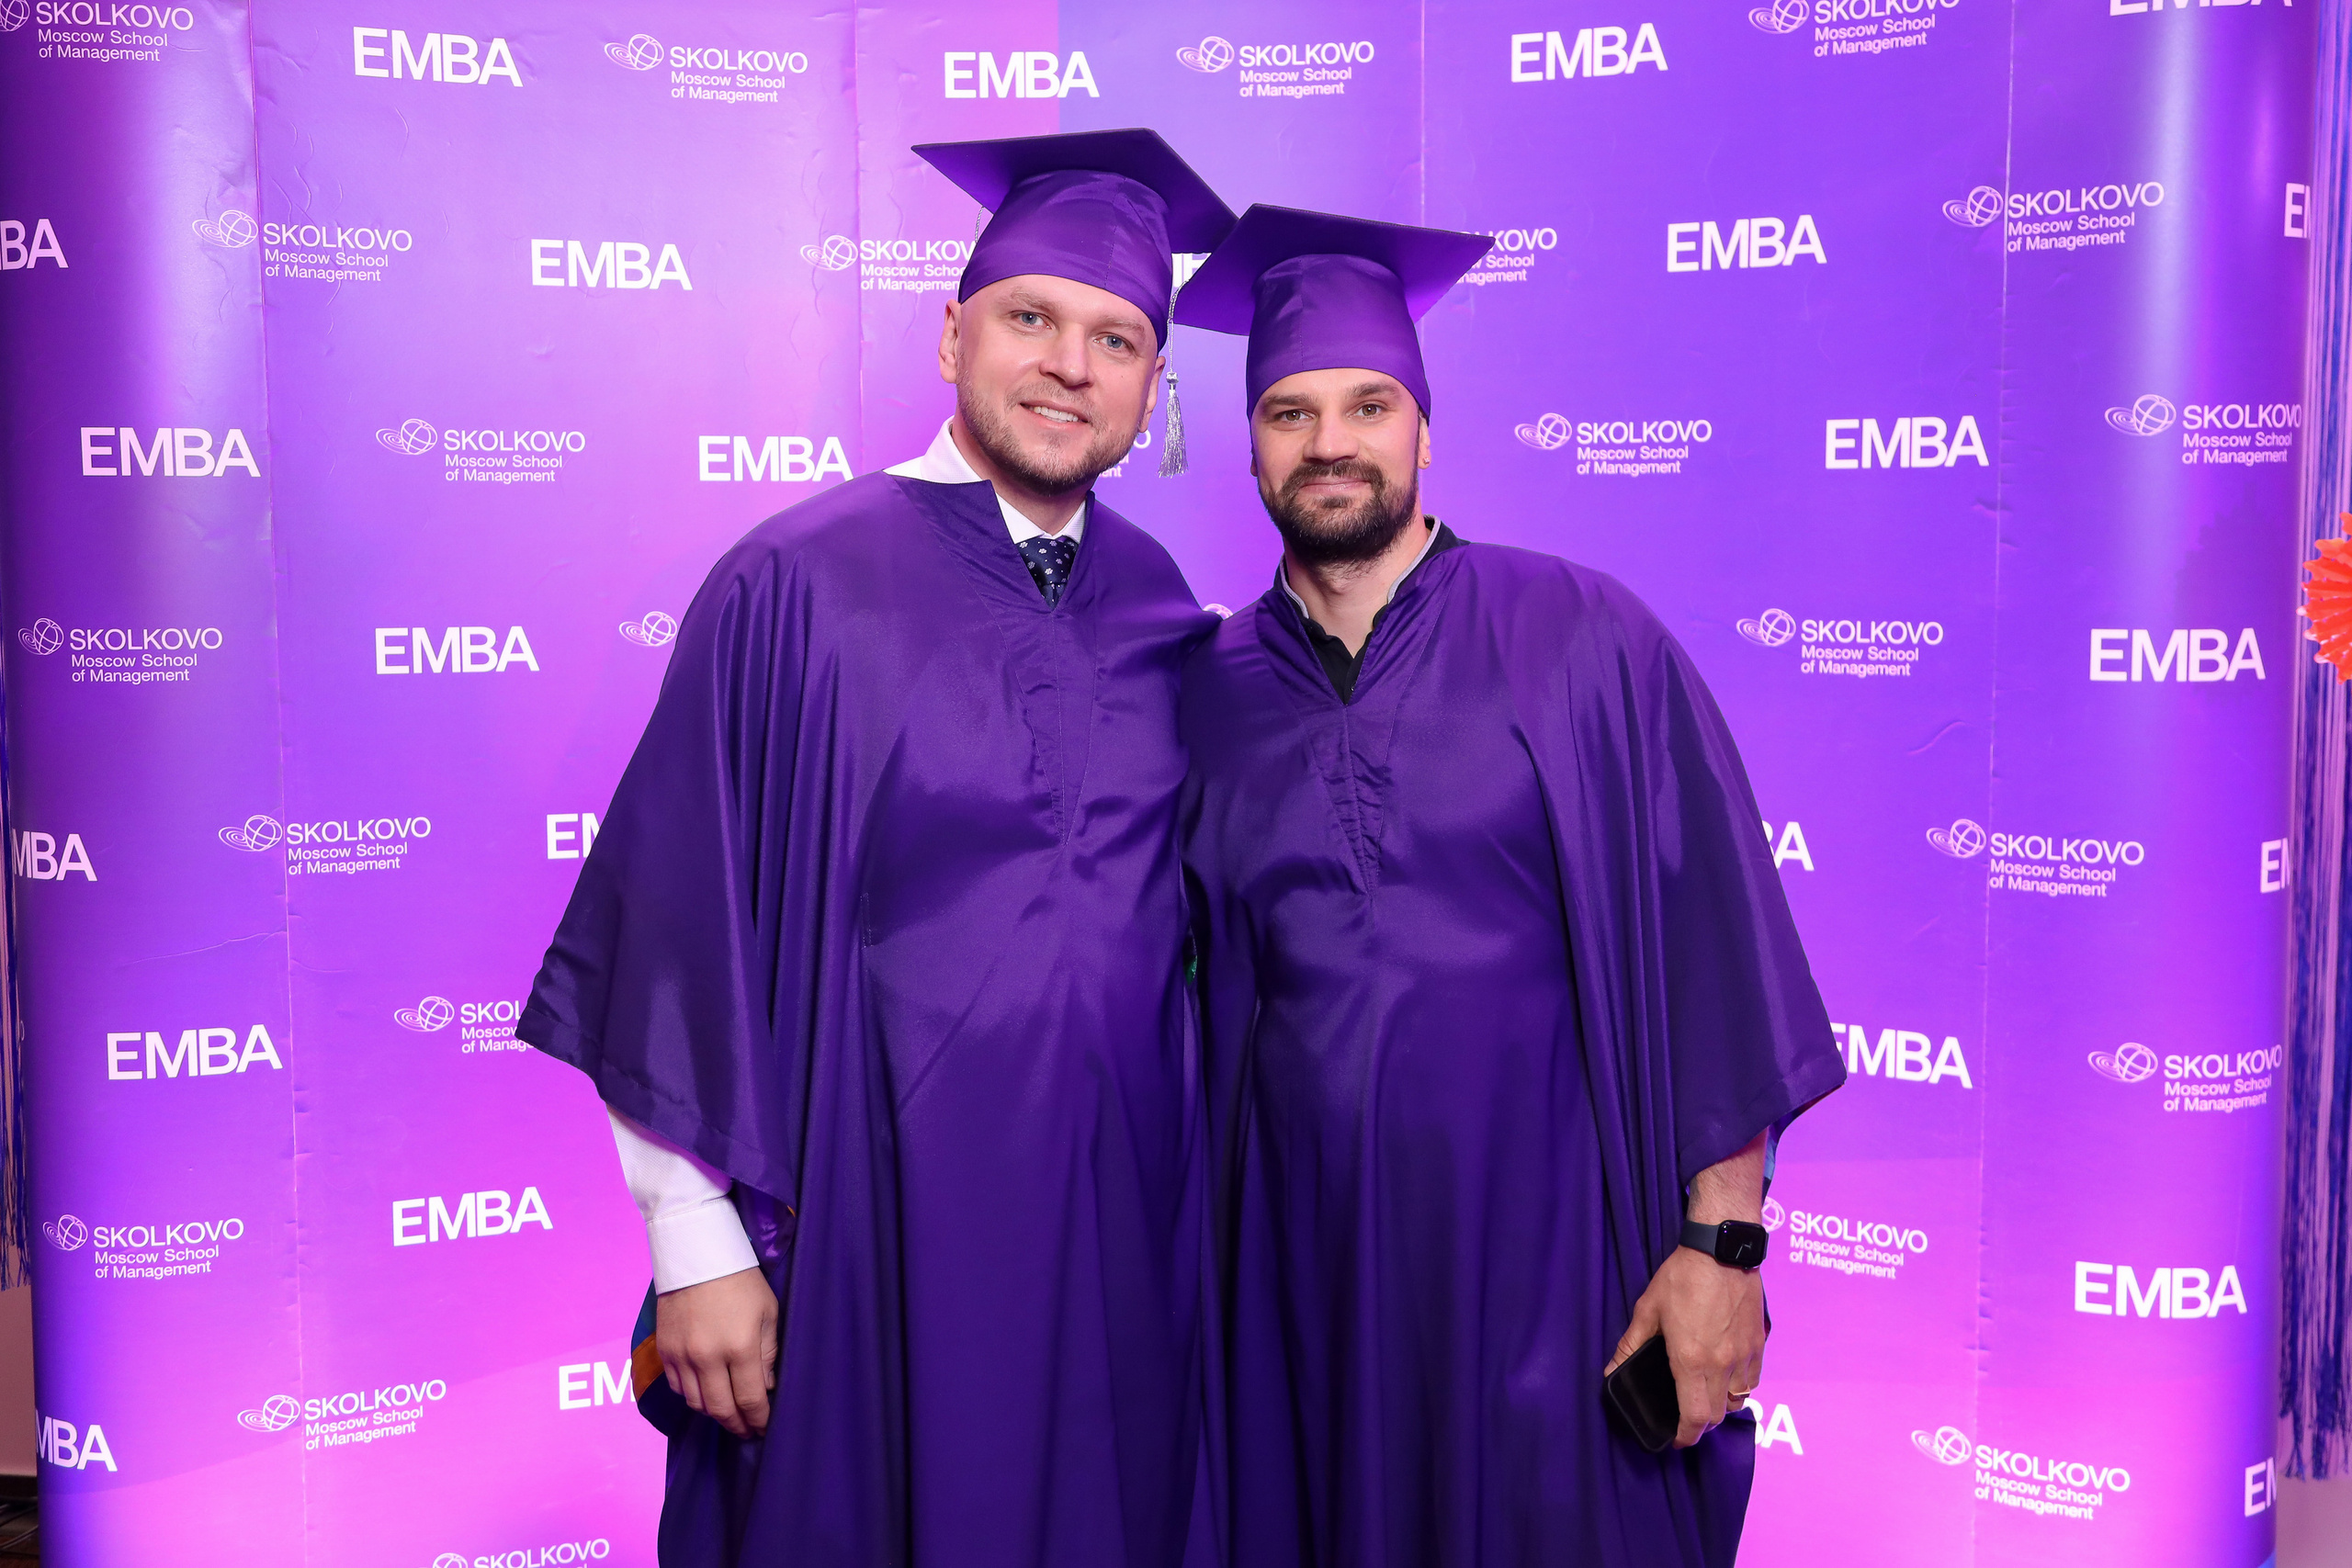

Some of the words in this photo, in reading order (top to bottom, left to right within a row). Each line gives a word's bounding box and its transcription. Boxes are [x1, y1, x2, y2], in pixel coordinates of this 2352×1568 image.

[36, 2, 194, 31] SKOLKOVO
[1815, 24, 1878, 41] Moscow
[1882, 14, 1936, 34] School
[39, 28, 104, 42] Moscow
[110, 30, 168, 46] School
[1814, 42, 1828, 57] of
[1832, 31, 1928, 54] Management
[40, 44, 53, 58] of
[58, 44, 160, 62] Management
[354, 27, 524, 87] EMBA
[670, 46, 808, 73] SKOLKOVO
[1239, 41, 1374, 67] SKOLKOVO
[1511, 23, 1668, 83] EMBA
[672, 72, 731, 85] Moscow
[737, 74, 786, 88] School
[944, 51, 1100, 98] EMBA
[1240, 70, 1299, 82] Moscow
[1304, 67, 1351, 81] School
[672, 86, 685, 98] of
[690, 86, 778, 103] Management
[1240, 85, 1253, 97] of
[1257, 83, 1344, 99] Management
[2007, 182, 2165, 219] SKOLKOVO
[264, 223, 413, 251] SKOLKOVO
[2007, 220, 2073, 237] Moscow
[2077, 212, 2134, 230] School
[0, 219, 68, 270] BA
[860, 240, 976, 261] SKOLKOV
[1668, 215, 1826, 272] EMBA
[2007, 236, 2021, 252] of
[2025, 230, 2125, 250] Management
[266, 249, 330, 264] Moscow
[336, 253, 389, 267] School
[532, 240, 692, 290] EMBA
[861, 264, 920, 277] Moscow
[1486, 254, 1535, 268] School
[266, 265, 279, 277] of
[285, 265, 381, 282] Management
[861, 278, 875, 290] of
[878, 278, 960, 293] Managemen
[1456, 269, 1527, 286] nagement
[2183, 404, 2301, 429] SKOLKOVO
[444, 430, 585, 453] SKOLKOVO
[1577, 420, 1712, 445] SKOLKOVO
[1826, 415, 1989, 469] EMBA
[2183, 433, 2251, 447] Moscow
[2255, 431, 2292, 446] School
[81, 427, 261, 477] EMBA
[446, 455, 507, 468] Moscow
[513, 455, 562, 468] School
[698, 435, 854, 481] EMBA
[1577, 447, 1635, 460] Moscow
[1640, 446, 1689, 459] School
[2182, 449, 2199, 464] of
[2203, 449, 2288, 467] Management
[446, 468, 458, 481] of
[464, 468, 555, 484] Management
[1577, 461, 1590, 475] of
[1594, 461, 1681, 478] Management
[70, 627, 222, 650] SKOLKOVO
[1801, 619, 1943, 646] SKOLKOVO
[72, 654, 136, 668] Moscow
[142, 653, 198, 668] School
[376, 626, 539, 674] EMBA
[1802, 645, 1863, 660] Moscow
[1868, 646, 1919, 661] School
[2090, 628, 2266, 682] EMBA
[72, 669, 85, 682] of
[90, 669, 189, 684] Management
[1801, 660, 1815, 674] of
[1818, 660, 1911, 678] Management
[287, 817, 431, 844] SKOLKOVO
[12, 829, 97, 881] MBA
[288, 848, 351, 862] Moscow
[356, 841, 408, 856] School
[1990, 833, 2144, 866] SKOLKOVO
[288, 862, 303, 875] of
[307, 857, 400, 874] Management
[1990, 859, 2054, 878] Moscow
[2058, 862, 2116, 883] School
[1989, 874, 2005, 889] of
[2008, 877, 2107, 897] Management
[460, 1000, 521, 1024] SKOL
[107, 1024, 283, 1080] EMBA
[461, 1040, 476, 1054] of
[2164, 1044, 2282, 1079] SKOLKOVO
[2164, 1081, 2231, 1096] Moscow
[2233, 1074, 2272, 1093] School
[2163, 1096, 2179, 1111] of
[2183, 1091, 2267, 1113] Management
[392, 1187, 553, 1247] EMBA
[94, 1218, 243, 1248] SKOLKOVO
[1790, 1211, 1928, 1254] SKOLKOVO
[95, 1250, 159, 1265] Moscow
[164, 1245, 220, 1261] School
[1791, 1235, 1850, 1257] Moscow
[1854, 1245, 1905, 1266] School
[95, 1265, 108, 1279] of
[113, 1260, 211, 1280] Management
[1790, 1250, 1804, 1263] of
[1807, 1251, 1896, 1280] Management
[2075, 1261, 2247, 1318] EMBA
[559, 1359, 637, 1410] EM
[304, 1380, 447, 1420] SKOLKOVO
[305, 1416, 368, 1437] Moscow
[373, 1405, 424, 1425] School
[36, 1410, 118, 1472] MBA
[305, 1435, 320, 1450] of
[324, 1421, 415, 1447] Management
[1975, 1445, 2131, 1493] SKOLKOVO
[1975, 1470, 2041, 1496] Moscow
[2046, 1484, 2103, 1506] School
[1974, 1486, 1990, 1500] of
[1994, 1488, 2094, 1520] Management
